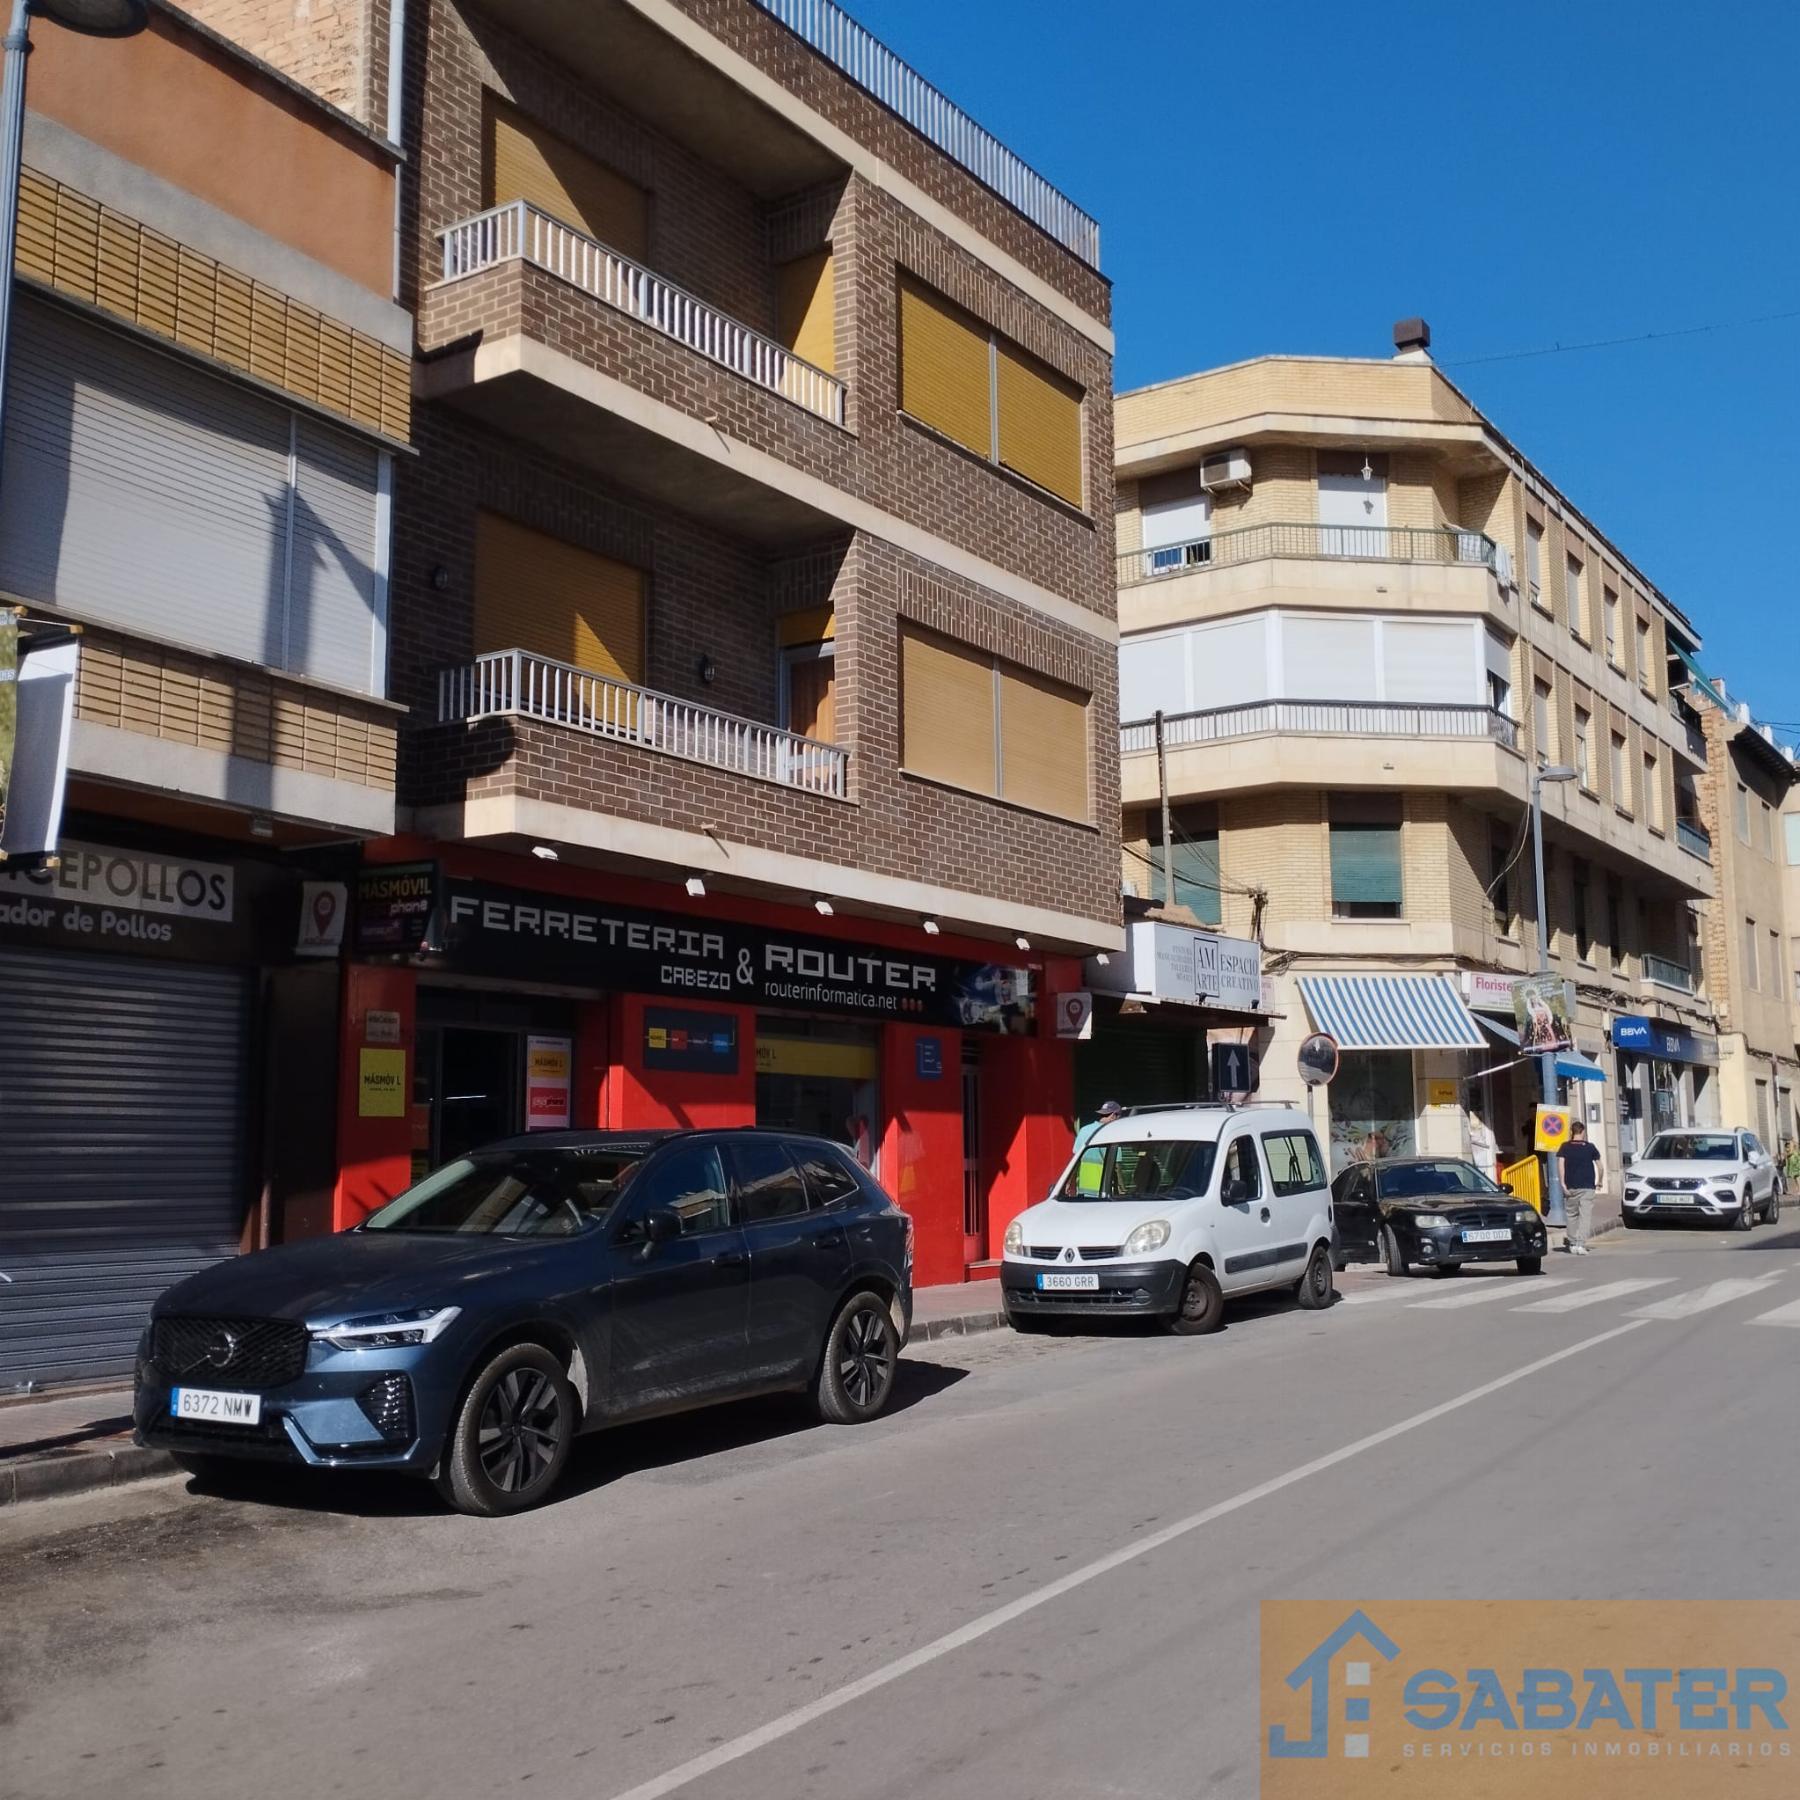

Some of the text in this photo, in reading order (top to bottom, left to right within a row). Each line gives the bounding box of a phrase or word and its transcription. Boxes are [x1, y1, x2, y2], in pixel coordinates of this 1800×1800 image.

[63, 904, 94, 933] de
[100, 909, 173, 942] Pollos
[451, 896, 724, 959] FERRETERIA
[736, 944, 937, 992] & ROUTER
[1197, 946, 1216, 971] AM
[1220, 953, 1259, 976] ESPACIO
[661, 965, 731, 991] CABEZO
[1196, 973, 1218, 992] ARTE
[1220, 975, 1259, 992] CREATIVO
[765, 980, 898, 1011] routerinformatica.net
[1620, 1027, 1647, 1036] BBVA
[1666, 1036, 1681, 1053] BBVA
[1046, 1276, 1095, 1288] 3660 GRR
[183, 1394, 253, 1418] 6372 NMW
